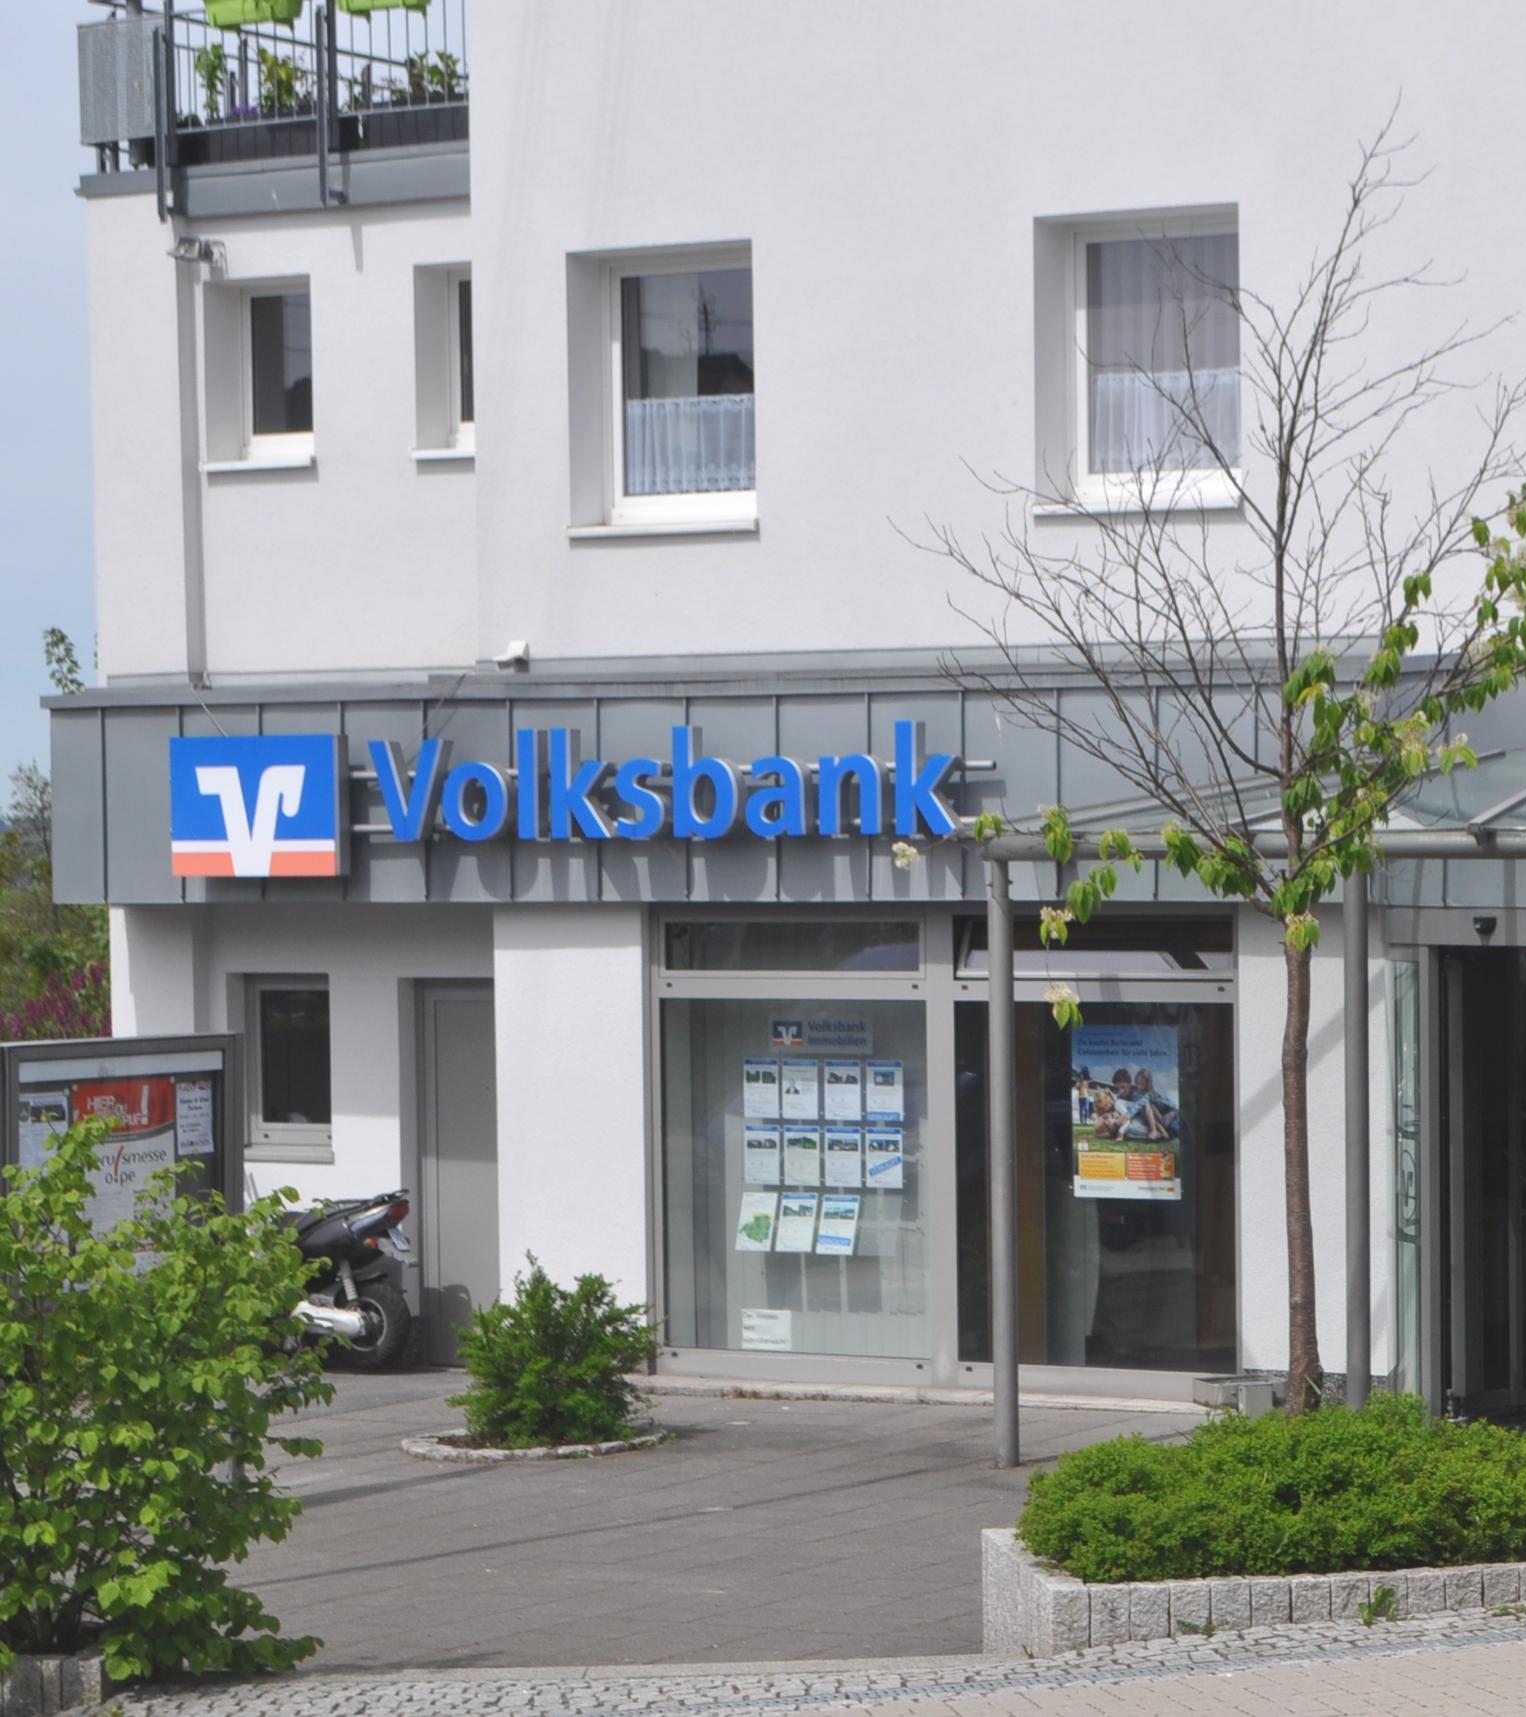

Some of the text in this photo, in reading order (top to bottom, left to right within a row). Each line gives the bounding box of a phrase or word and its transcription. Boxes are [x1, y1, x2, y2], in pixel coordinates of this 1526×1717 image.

[368, 720, 960, 842] Volksbank
[807, 1019, 867, 1033] Volksbank
[807, 1034, 868, 1047] Immobilien
